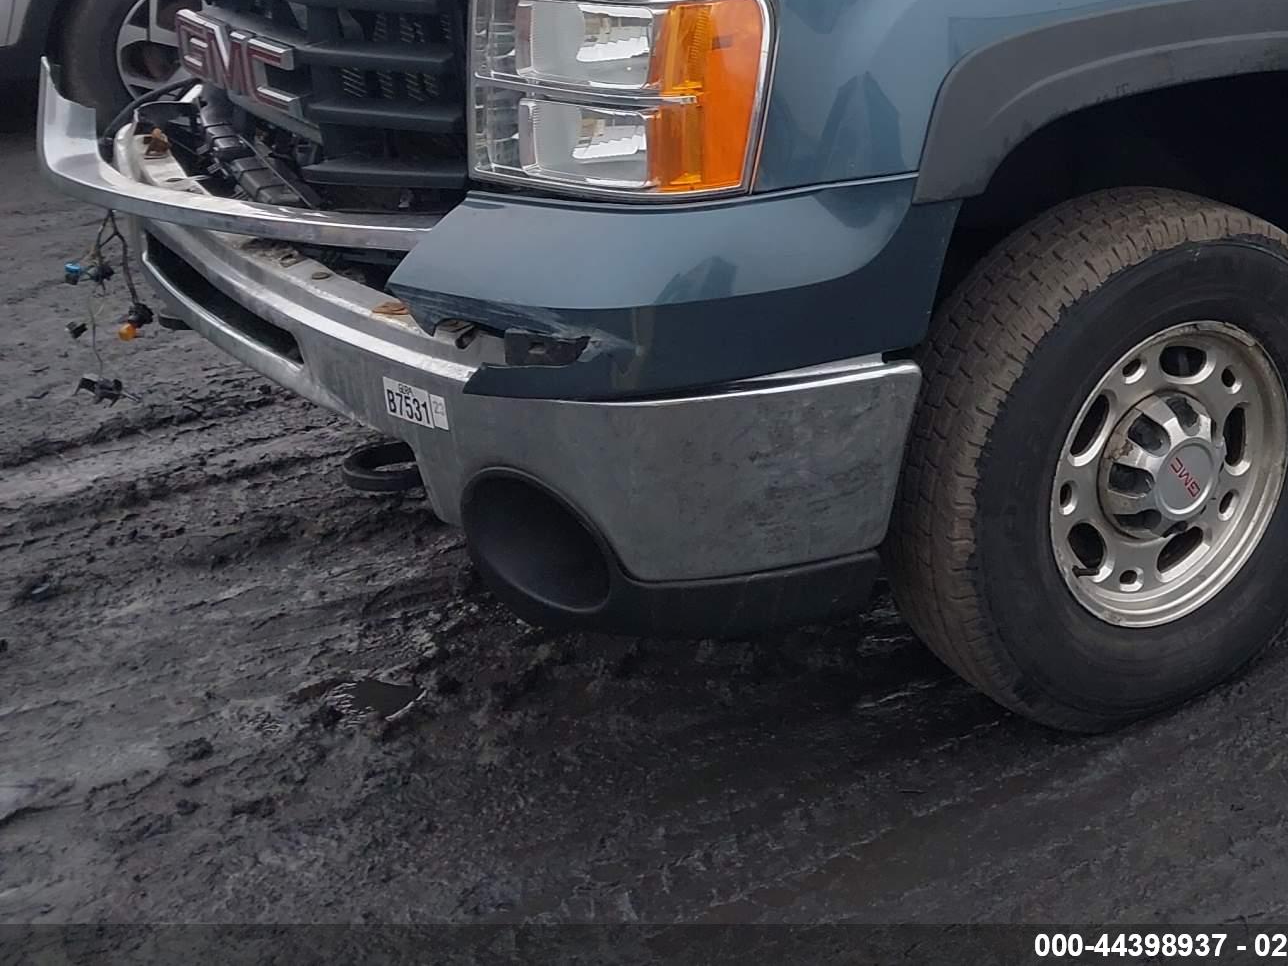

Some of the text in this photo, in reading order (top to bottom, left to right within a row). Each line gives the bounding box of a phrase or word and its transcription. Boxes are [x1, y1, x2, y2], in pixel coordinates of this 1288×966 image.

[176, 8, 303, 119] GMC
[386, 388, 431, 425] B7531
[1169, 457, 1201, 498] GMC
